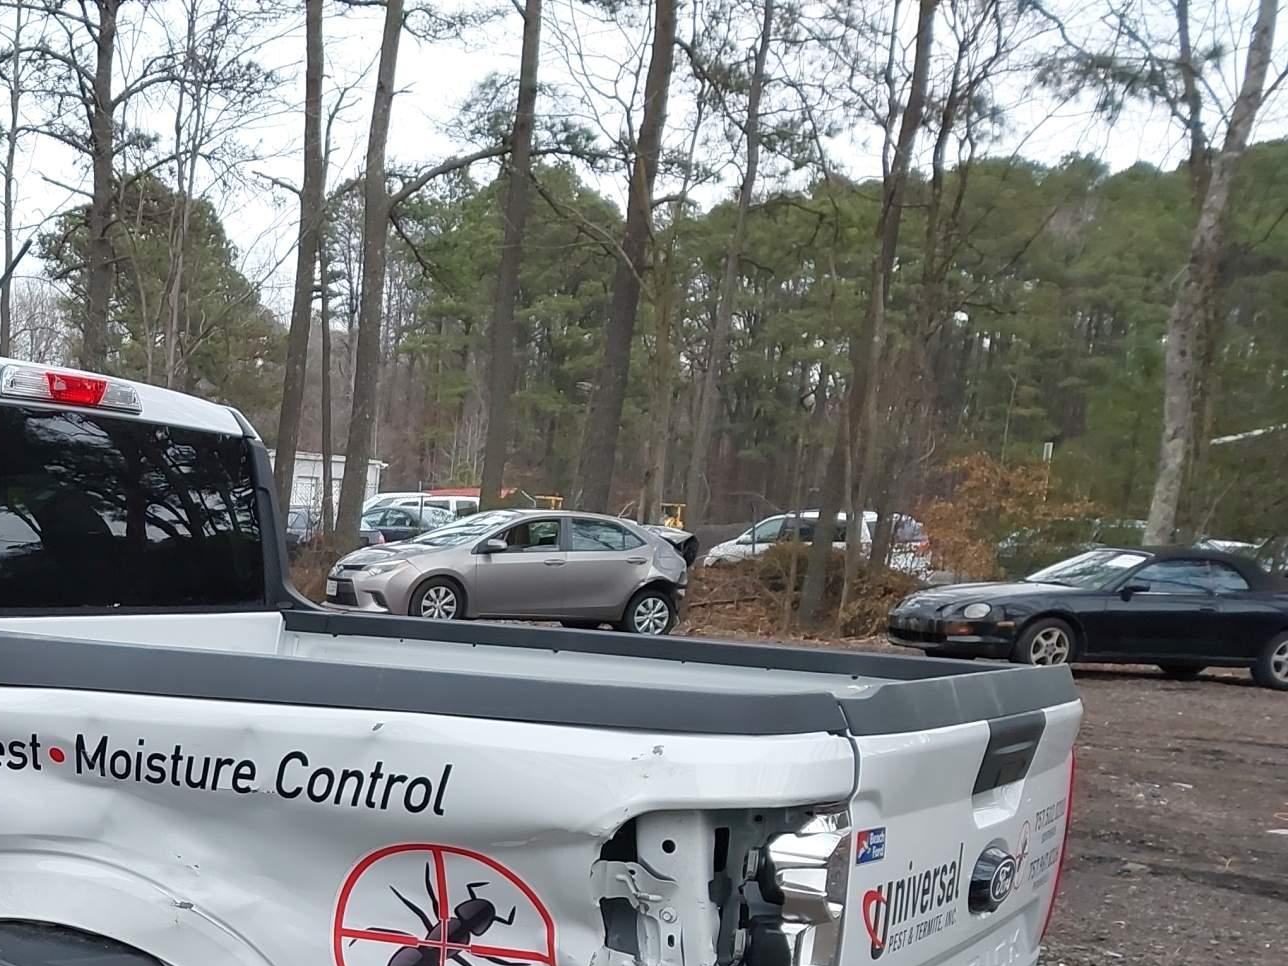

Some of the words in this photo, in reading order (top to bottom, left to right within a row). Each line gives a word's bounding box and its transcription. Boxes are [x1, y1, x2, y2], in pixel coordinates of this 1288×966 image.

[75, 733, 257, 794] Moisture
[275, 750, 453, 816] Control
[863, 841, 964, 960] Universal
[888, 929, 907, 954] PEST
[908, 926, 914, 945] &
